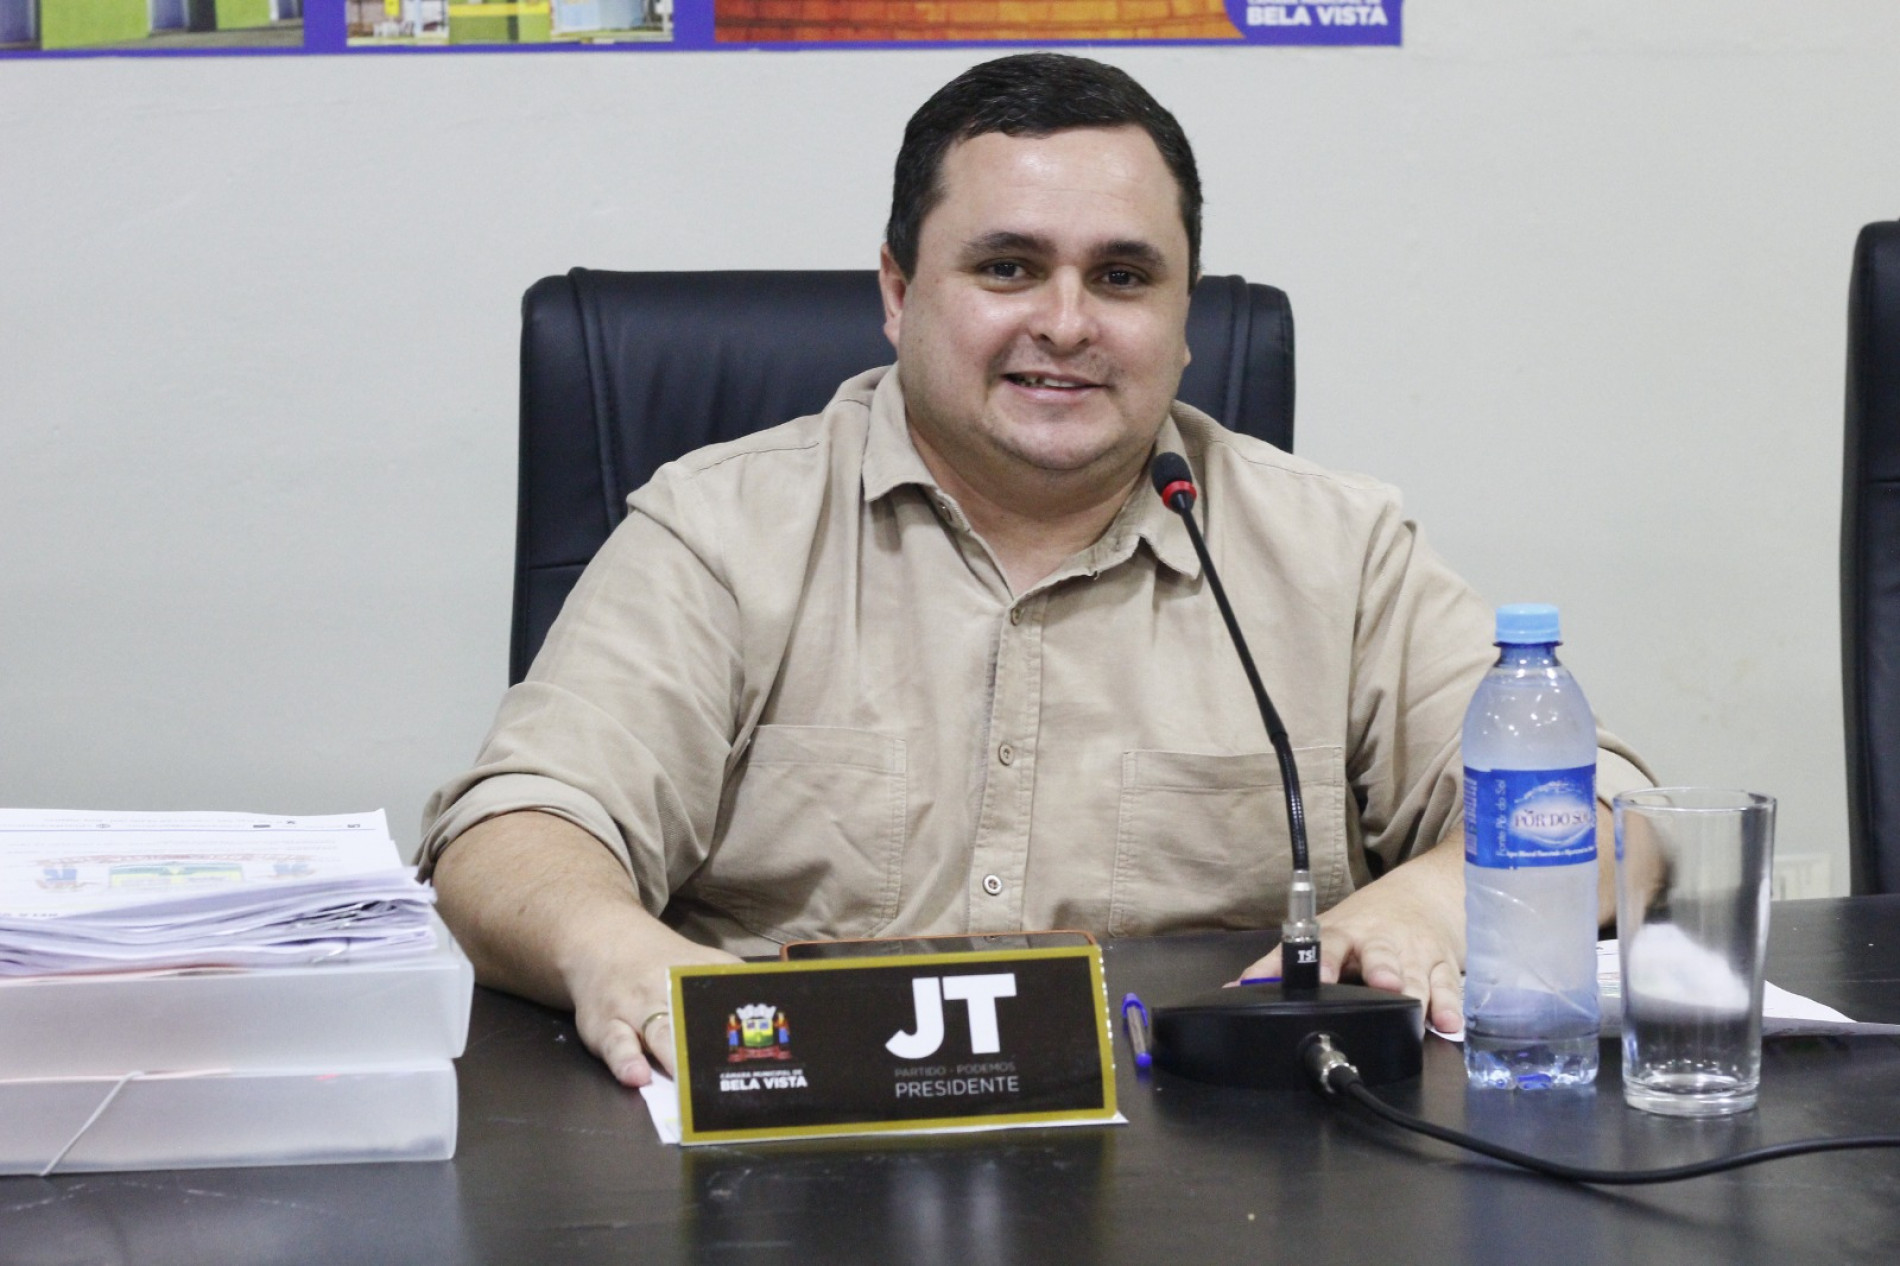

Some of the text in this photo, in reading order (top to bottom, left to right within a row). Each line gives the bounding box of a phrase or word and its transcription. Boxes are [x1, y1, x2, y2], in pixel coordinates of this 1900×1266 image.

[1246, 5, 1389, 26] BELA VISTA
[885, 972, 1017, 1060] JT
[894, 1065, 947, 1078] PARTIDO
[956, 1061, 1017, 1075] PODEMOS
[720, 1076, 807, 1091] BELA VISTA
[895, 1075, 1020, 1099] PRESIDENTE
